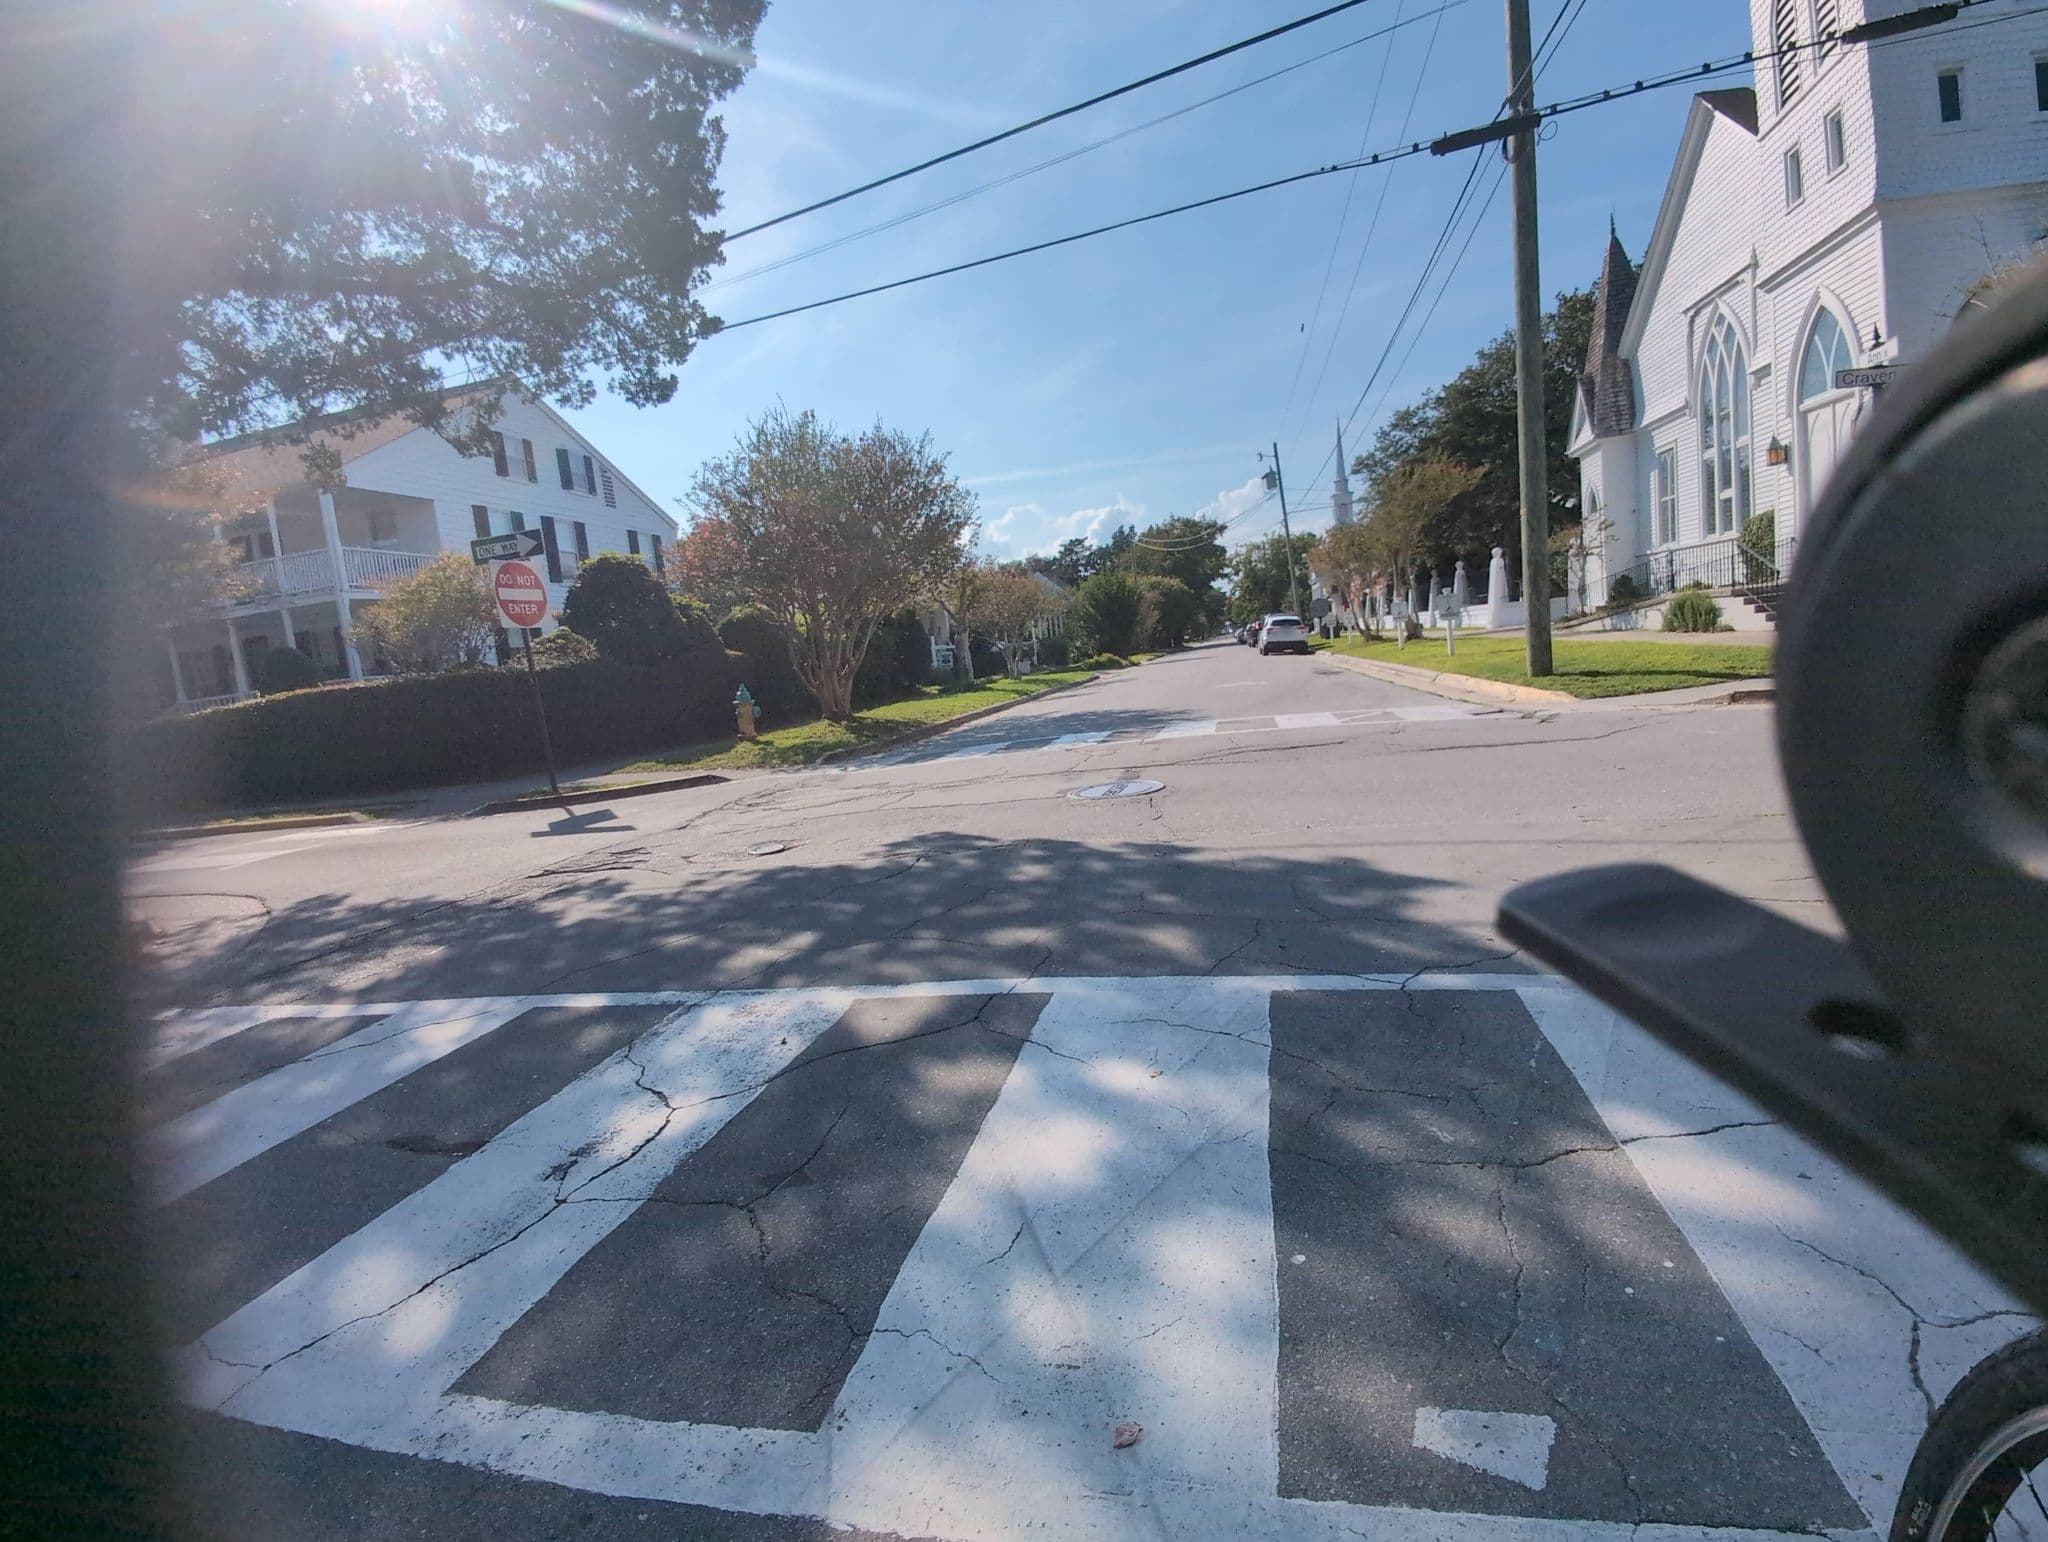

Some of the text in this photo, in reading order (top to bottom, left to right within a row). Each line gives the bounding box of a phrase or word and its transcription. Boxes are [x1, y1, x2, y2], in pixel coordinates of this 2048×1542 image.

[1842, 370, 1897, 385] Craven
[478, 541, 519, 558] ONE WAY
[500, 574, 536, 586] DO NOT
[508, 604, 538, 614] ENTER
